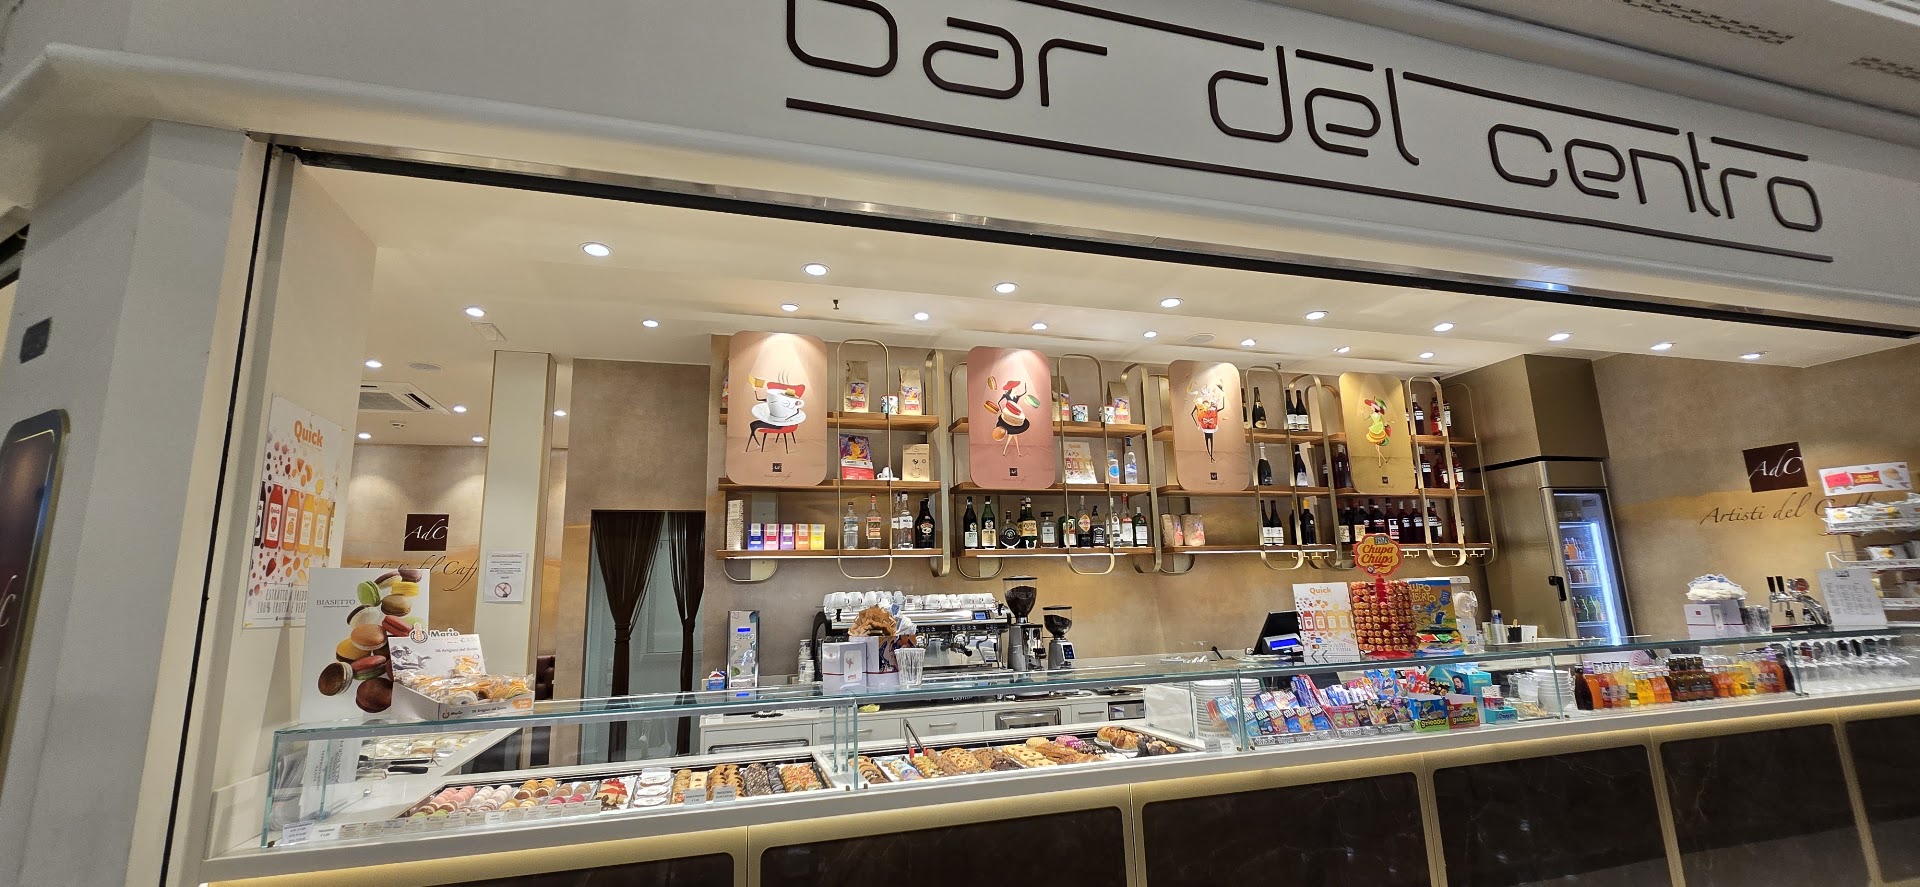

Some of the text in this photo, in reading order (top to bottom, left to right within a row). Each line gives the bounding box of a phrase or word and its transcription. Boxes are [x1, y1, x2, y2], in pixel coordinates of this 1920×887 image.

[786, 0, 1823, 232] bar del centro
[294, 419, 324, 448] Quick
[1749, 448, 1803, 478] AdC
[1699, 505, 1765, 526] Artisti
[1773, 491, 1813, 521] del
[404, 518, 449, 541] AdC
[1362, 544, 1394, 555] Chupa
[1361, 553, 1394, 570] Chups
[1309, 586, 1332, 595] Quick
[430, 628, 459, 637] Mario
